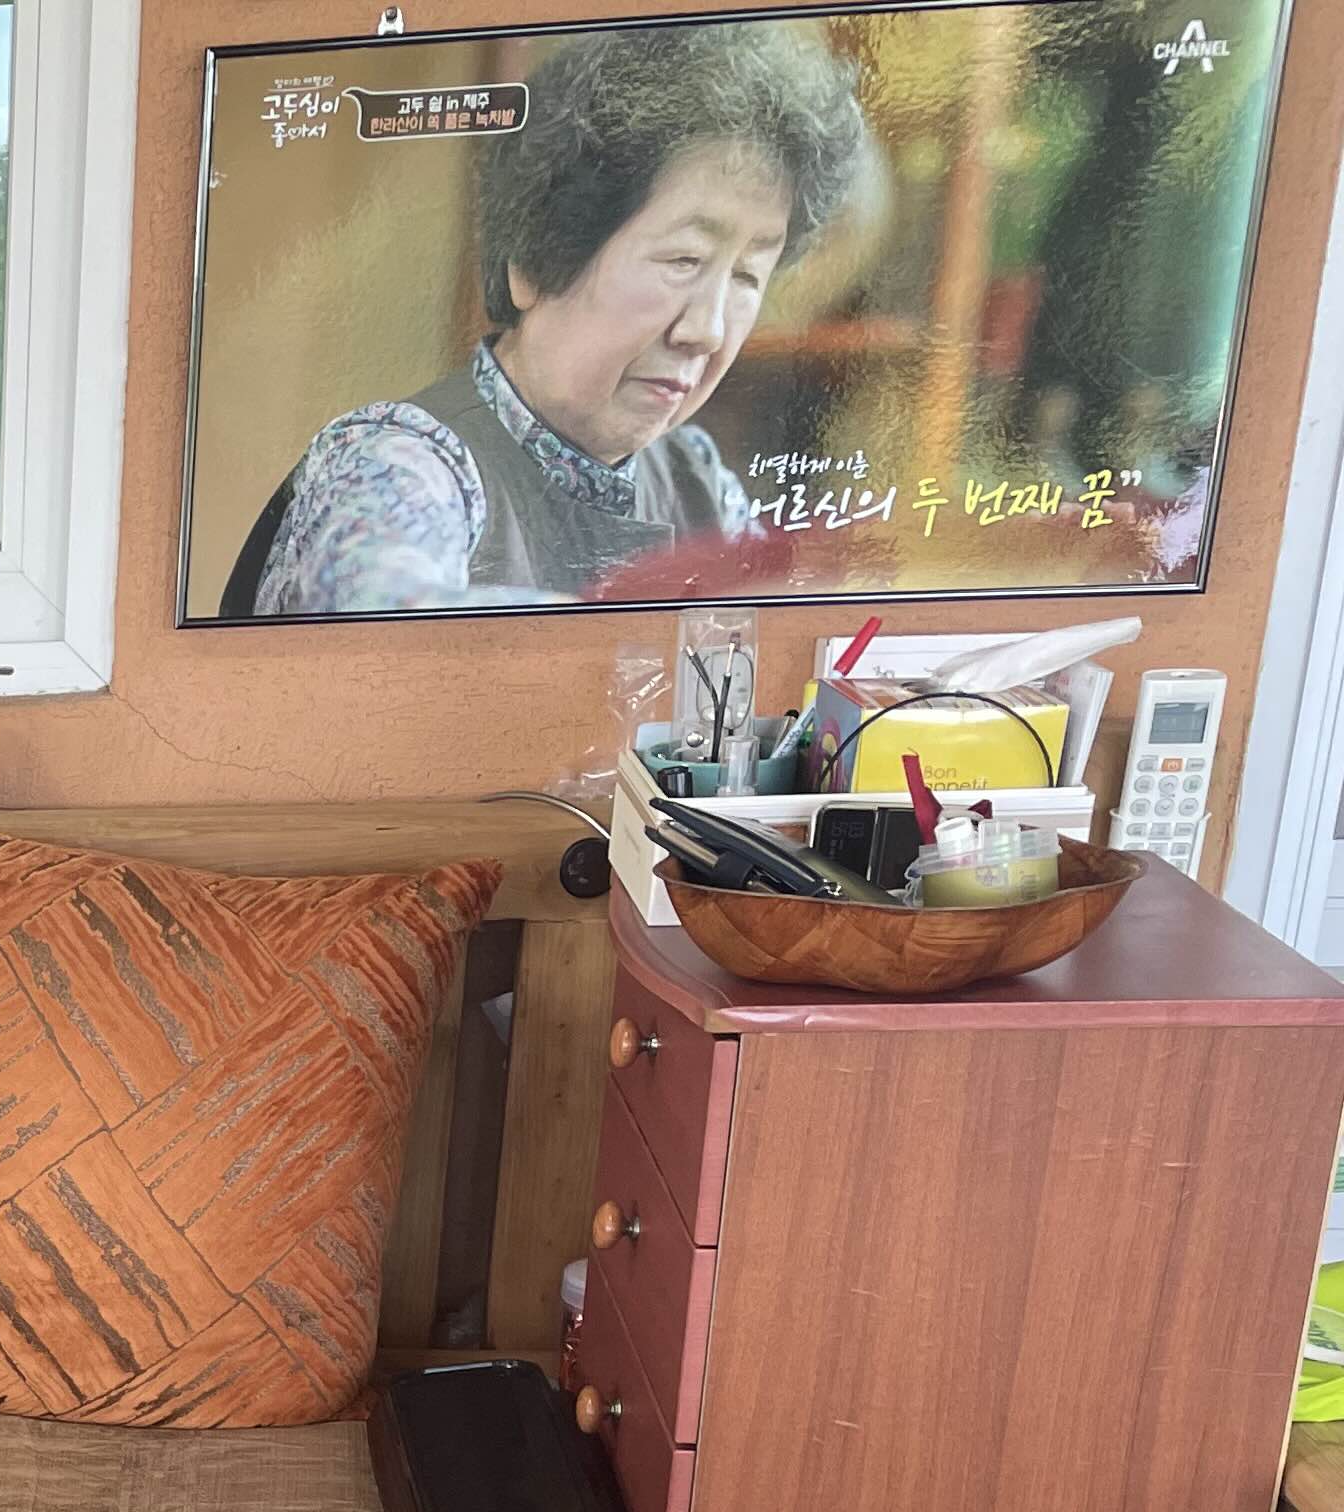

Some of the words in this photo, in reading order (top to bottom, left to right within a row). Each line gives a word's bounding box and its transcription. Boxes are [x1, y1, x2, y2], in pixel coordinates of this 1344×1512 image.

[1153, 40, 1231, 60] CHANNEL
[260, 92, 340, 120] 고두심이
[398, 97, 425, 115] 고두
[446, 95, 459, 111] in
[462, 92, 491, 110] 제주
[370, 117, 424, 135] 한라산이
[475, 108, 517, 127] 녹차밭
[748, 451, 832, 485] 치열하게
[835, 449, 870, 480] 이룬
[911, 476, 949, 538] 두
[964, 480, 1064, 528] 번째
